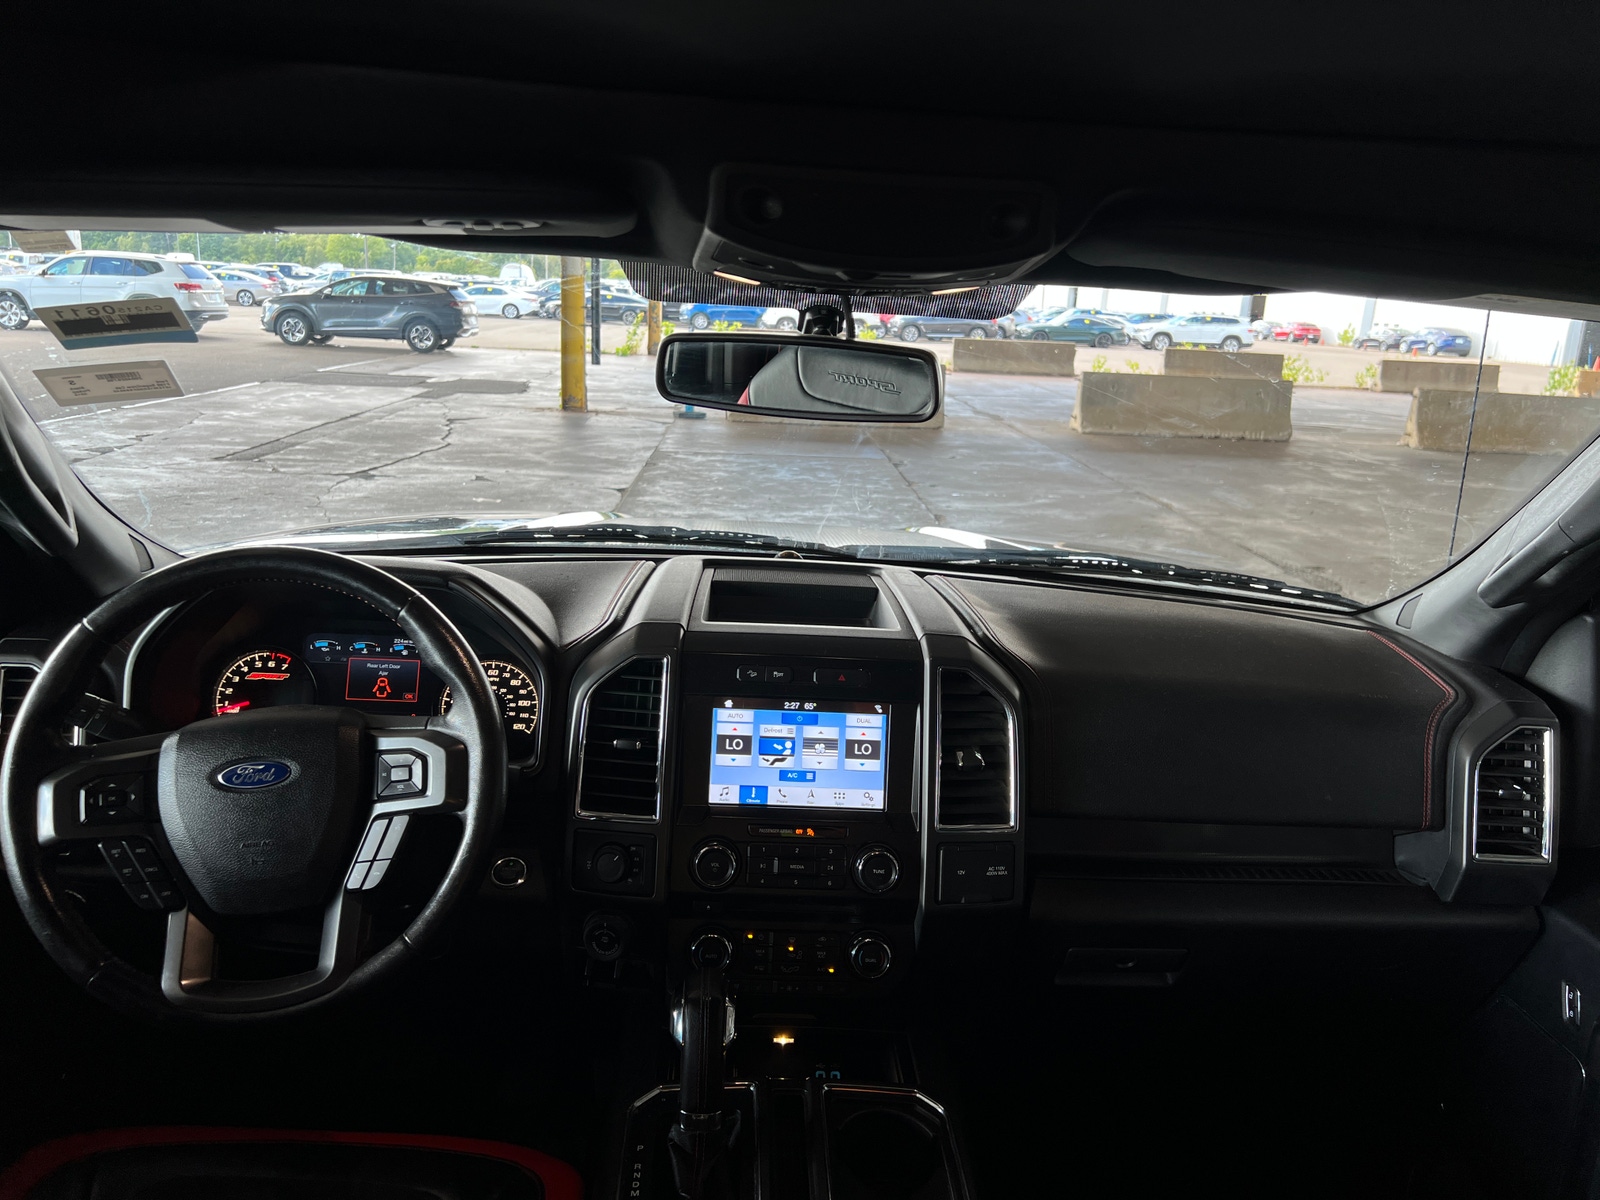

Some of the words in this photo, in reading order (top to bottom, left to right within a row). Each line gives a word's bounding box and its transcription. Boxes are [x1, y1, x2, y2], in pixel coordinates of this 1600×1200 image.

[726, 739, 743, 750] LO
[854, 744, 871, 755] LO
[233, 765, 275, 784] Ford
